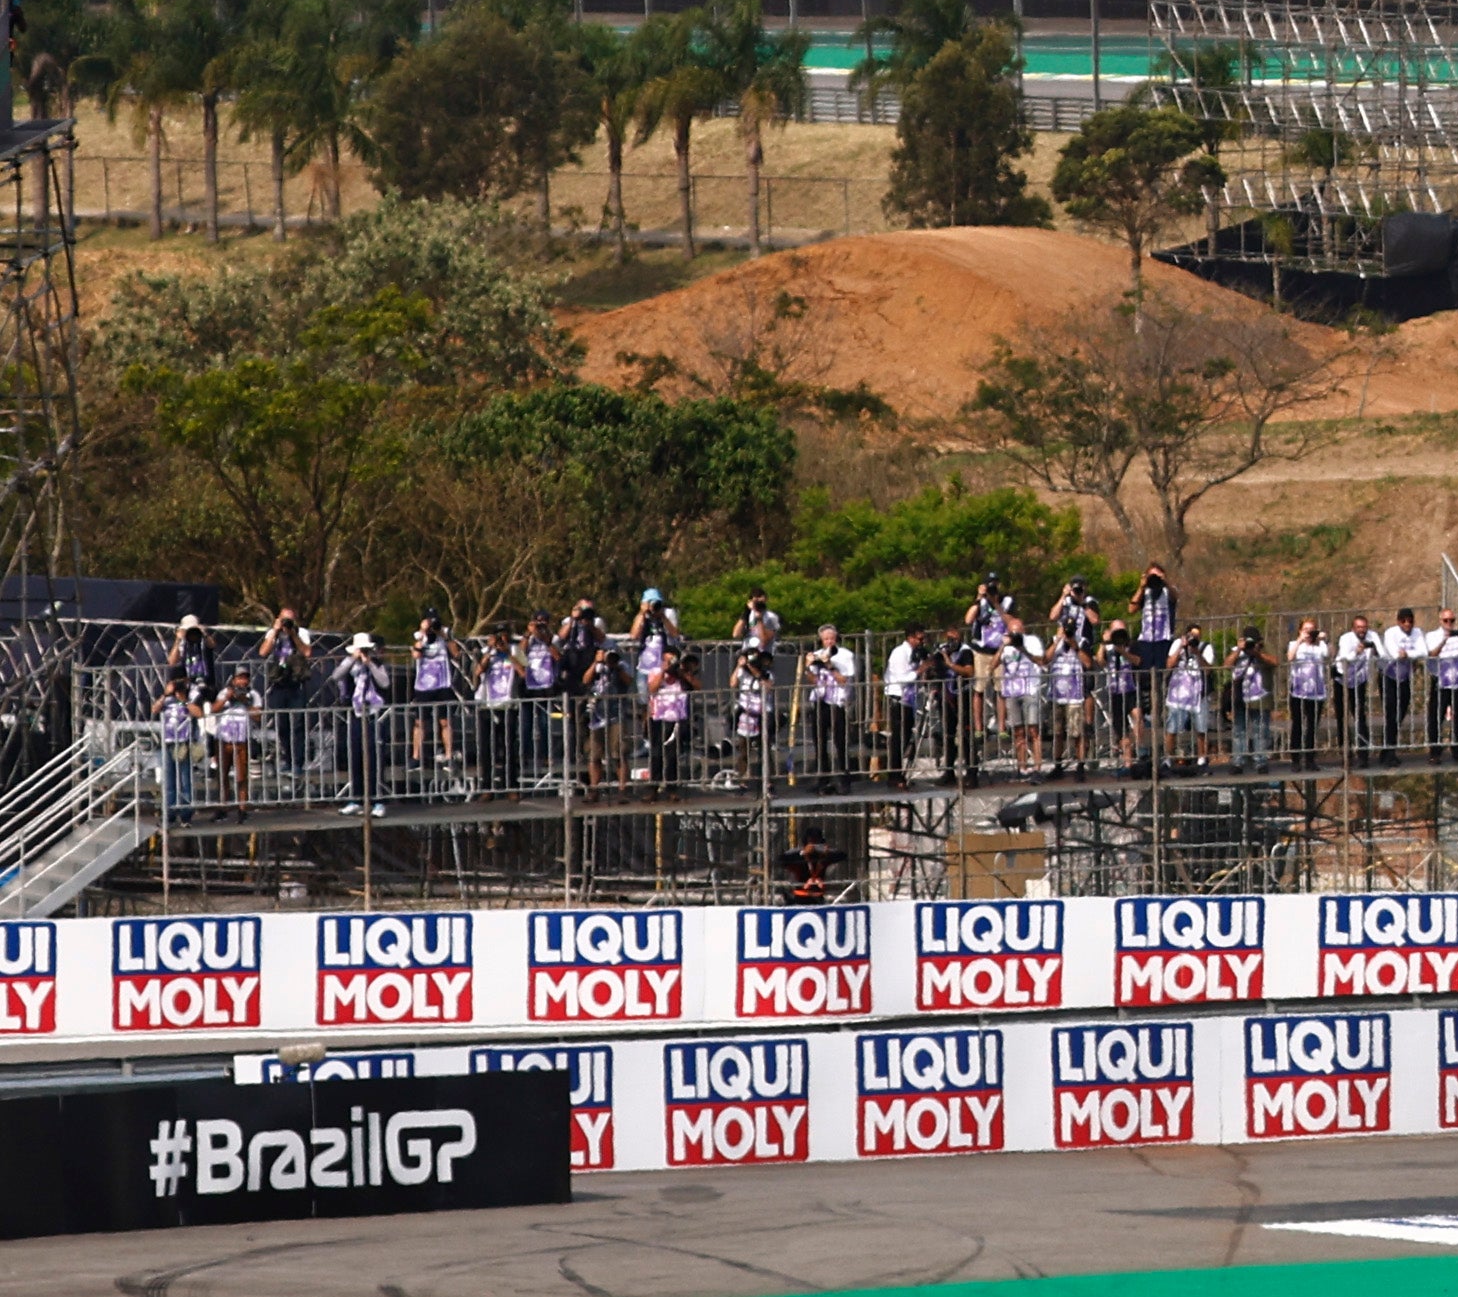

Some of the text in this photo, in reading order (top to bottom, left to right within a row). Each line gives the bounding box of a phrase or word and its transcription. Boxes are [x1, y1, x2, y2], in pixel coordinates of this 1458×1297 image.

[118, 920, 257, 973] LIQUI
[321, 917, 469, 969] LIQUI
[533, 914, 678, 966] LIQUI
[741, 909, 868, 961] LIQUI
[921, 904, 1058, 955] LIQUI
[1119, 901, 1260, 950] LIQUI
[118, 975, 257, 1027] MOLY
[321, 971, 469, 1022] MOLY
[533, 968, 678, 1017] MOLY
[741, 963, 868, 1014] MOLY
[921, 957, 1058, 1007] MOLY
[1119, 952, 1260, 1003] MOLY
[862, 1034, 1001, 1091] LIQUI
[1251, 1017, 1386, 1074] LIQUI
[671, 1043, 805, 1101] LIQUI
[862, 1093, 1001, 1153] MOLY
[1251, 1076, 1386, 1134] MOLY
[149, 1105, 477, 1197] #BrazilGP
[671, 1103, 805, 1162] MOLY
